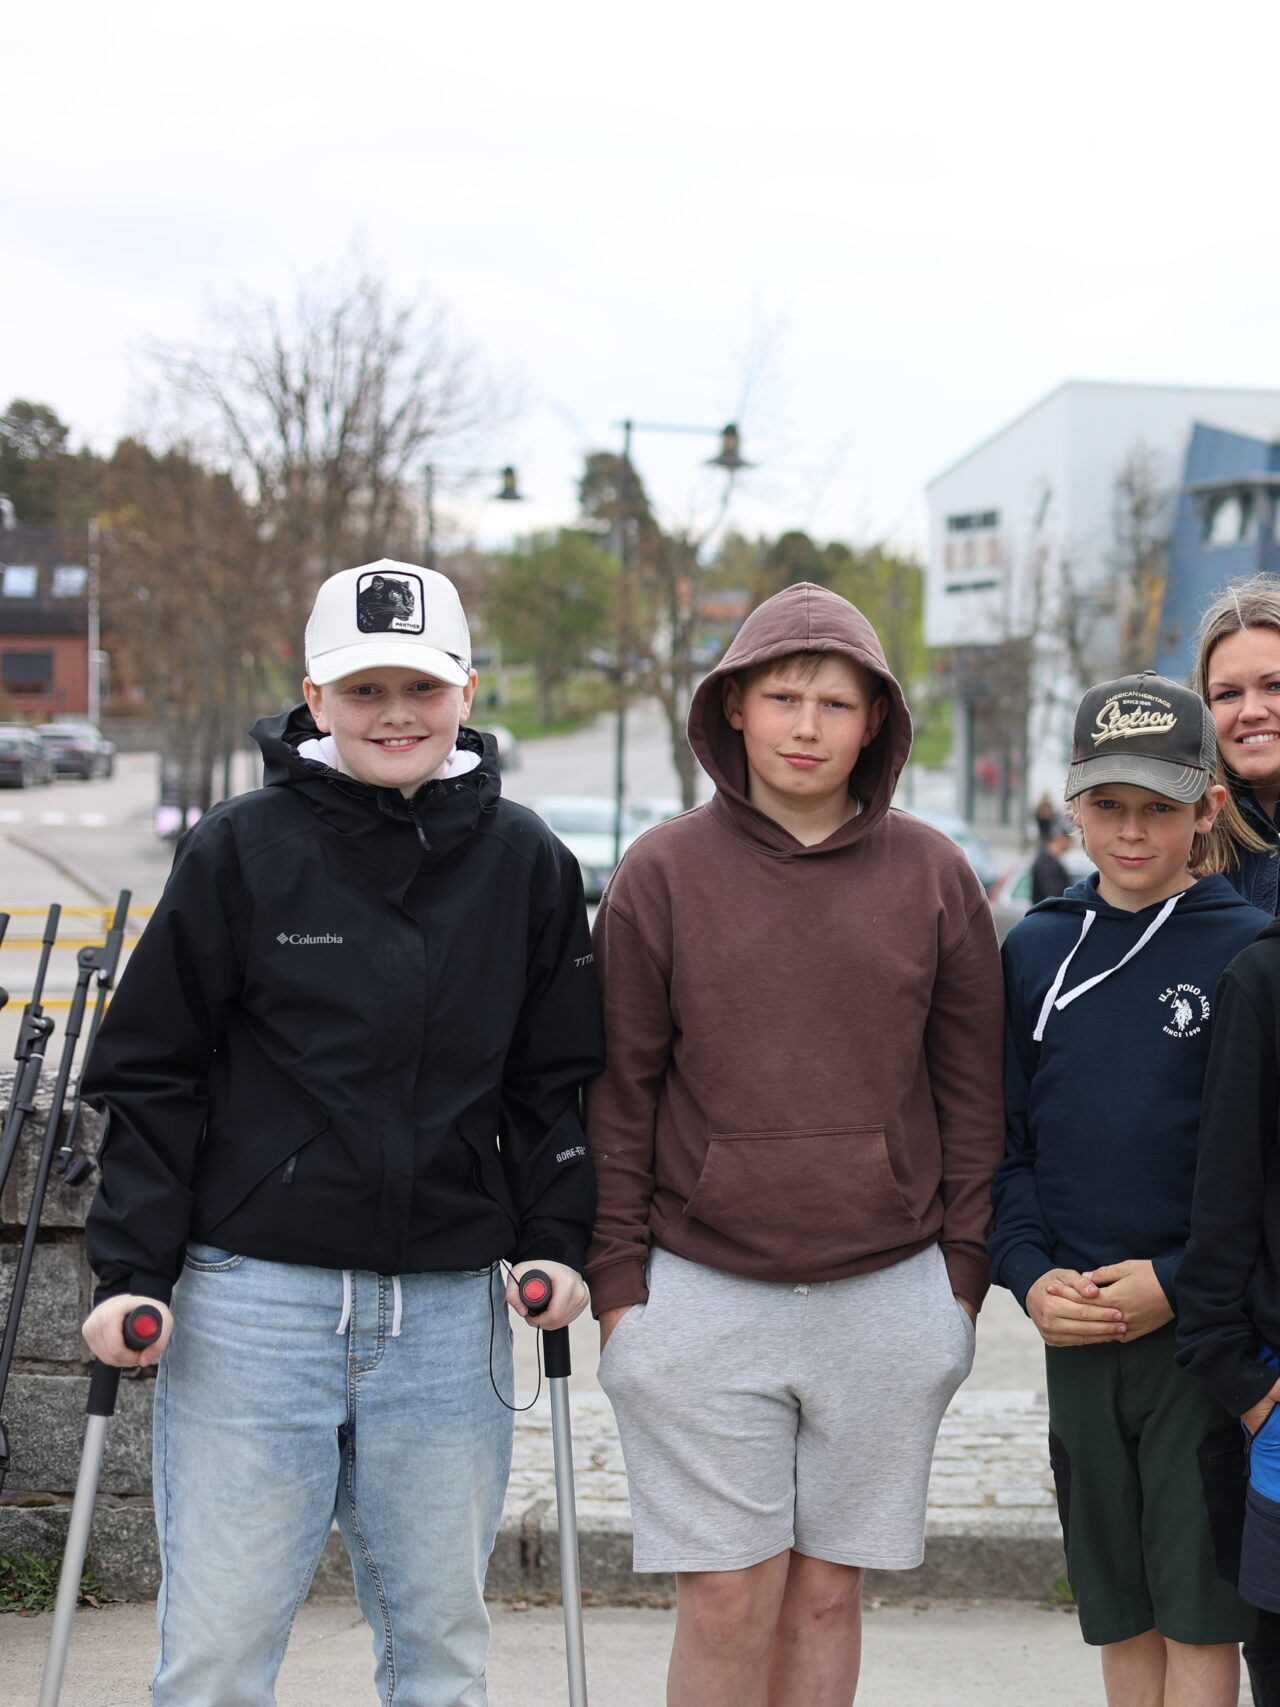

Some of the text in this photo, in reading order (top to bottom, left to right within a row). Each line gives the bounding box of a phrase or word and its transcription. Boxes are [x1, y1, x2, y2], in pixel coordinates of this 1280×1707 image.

[1105, 691, 1171, 708] AMERICAN HERITAGE
[1091, 701, 1177, 746] Stetson
[289, 933, 343, 945] Columbia
[1158, 984, 1210, 1021] U.S. POLO ASSN.
[1162, 1025, 1201, 1038] SINCE 1890
